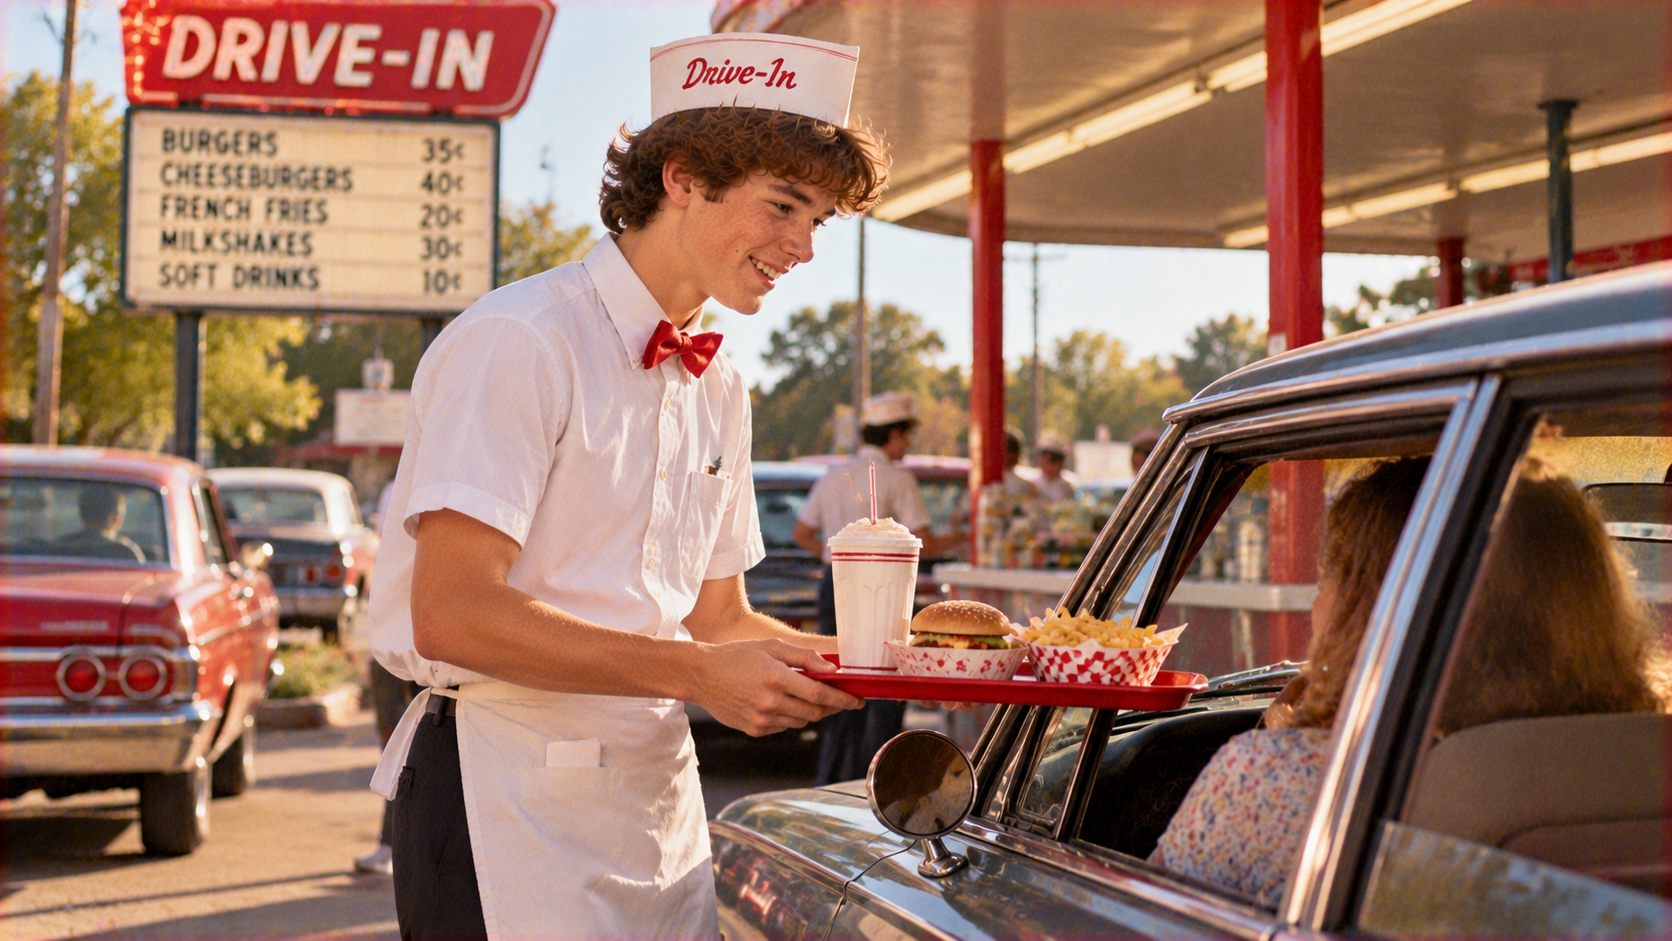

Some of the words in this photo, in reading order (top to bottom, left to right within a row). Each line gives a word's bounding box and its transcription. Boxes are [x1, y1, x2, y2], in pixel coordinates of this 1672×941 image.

[162, 15, 495, 91] DRIVE-IN
[682, 57, 797, 90] Drive-In
[162, 128, 278, 156] BURGERS
[160, 162, 353, 191] CHEESEBURGERS
[160, 197, 250, 220] FRENCH
[265, 198, 328, 224] FRIES
[160, 230, 313, 256] MILKSHAKES
[159, 263, 217, 287] SOFT
[232, 264, 319, 290] DRINKS
